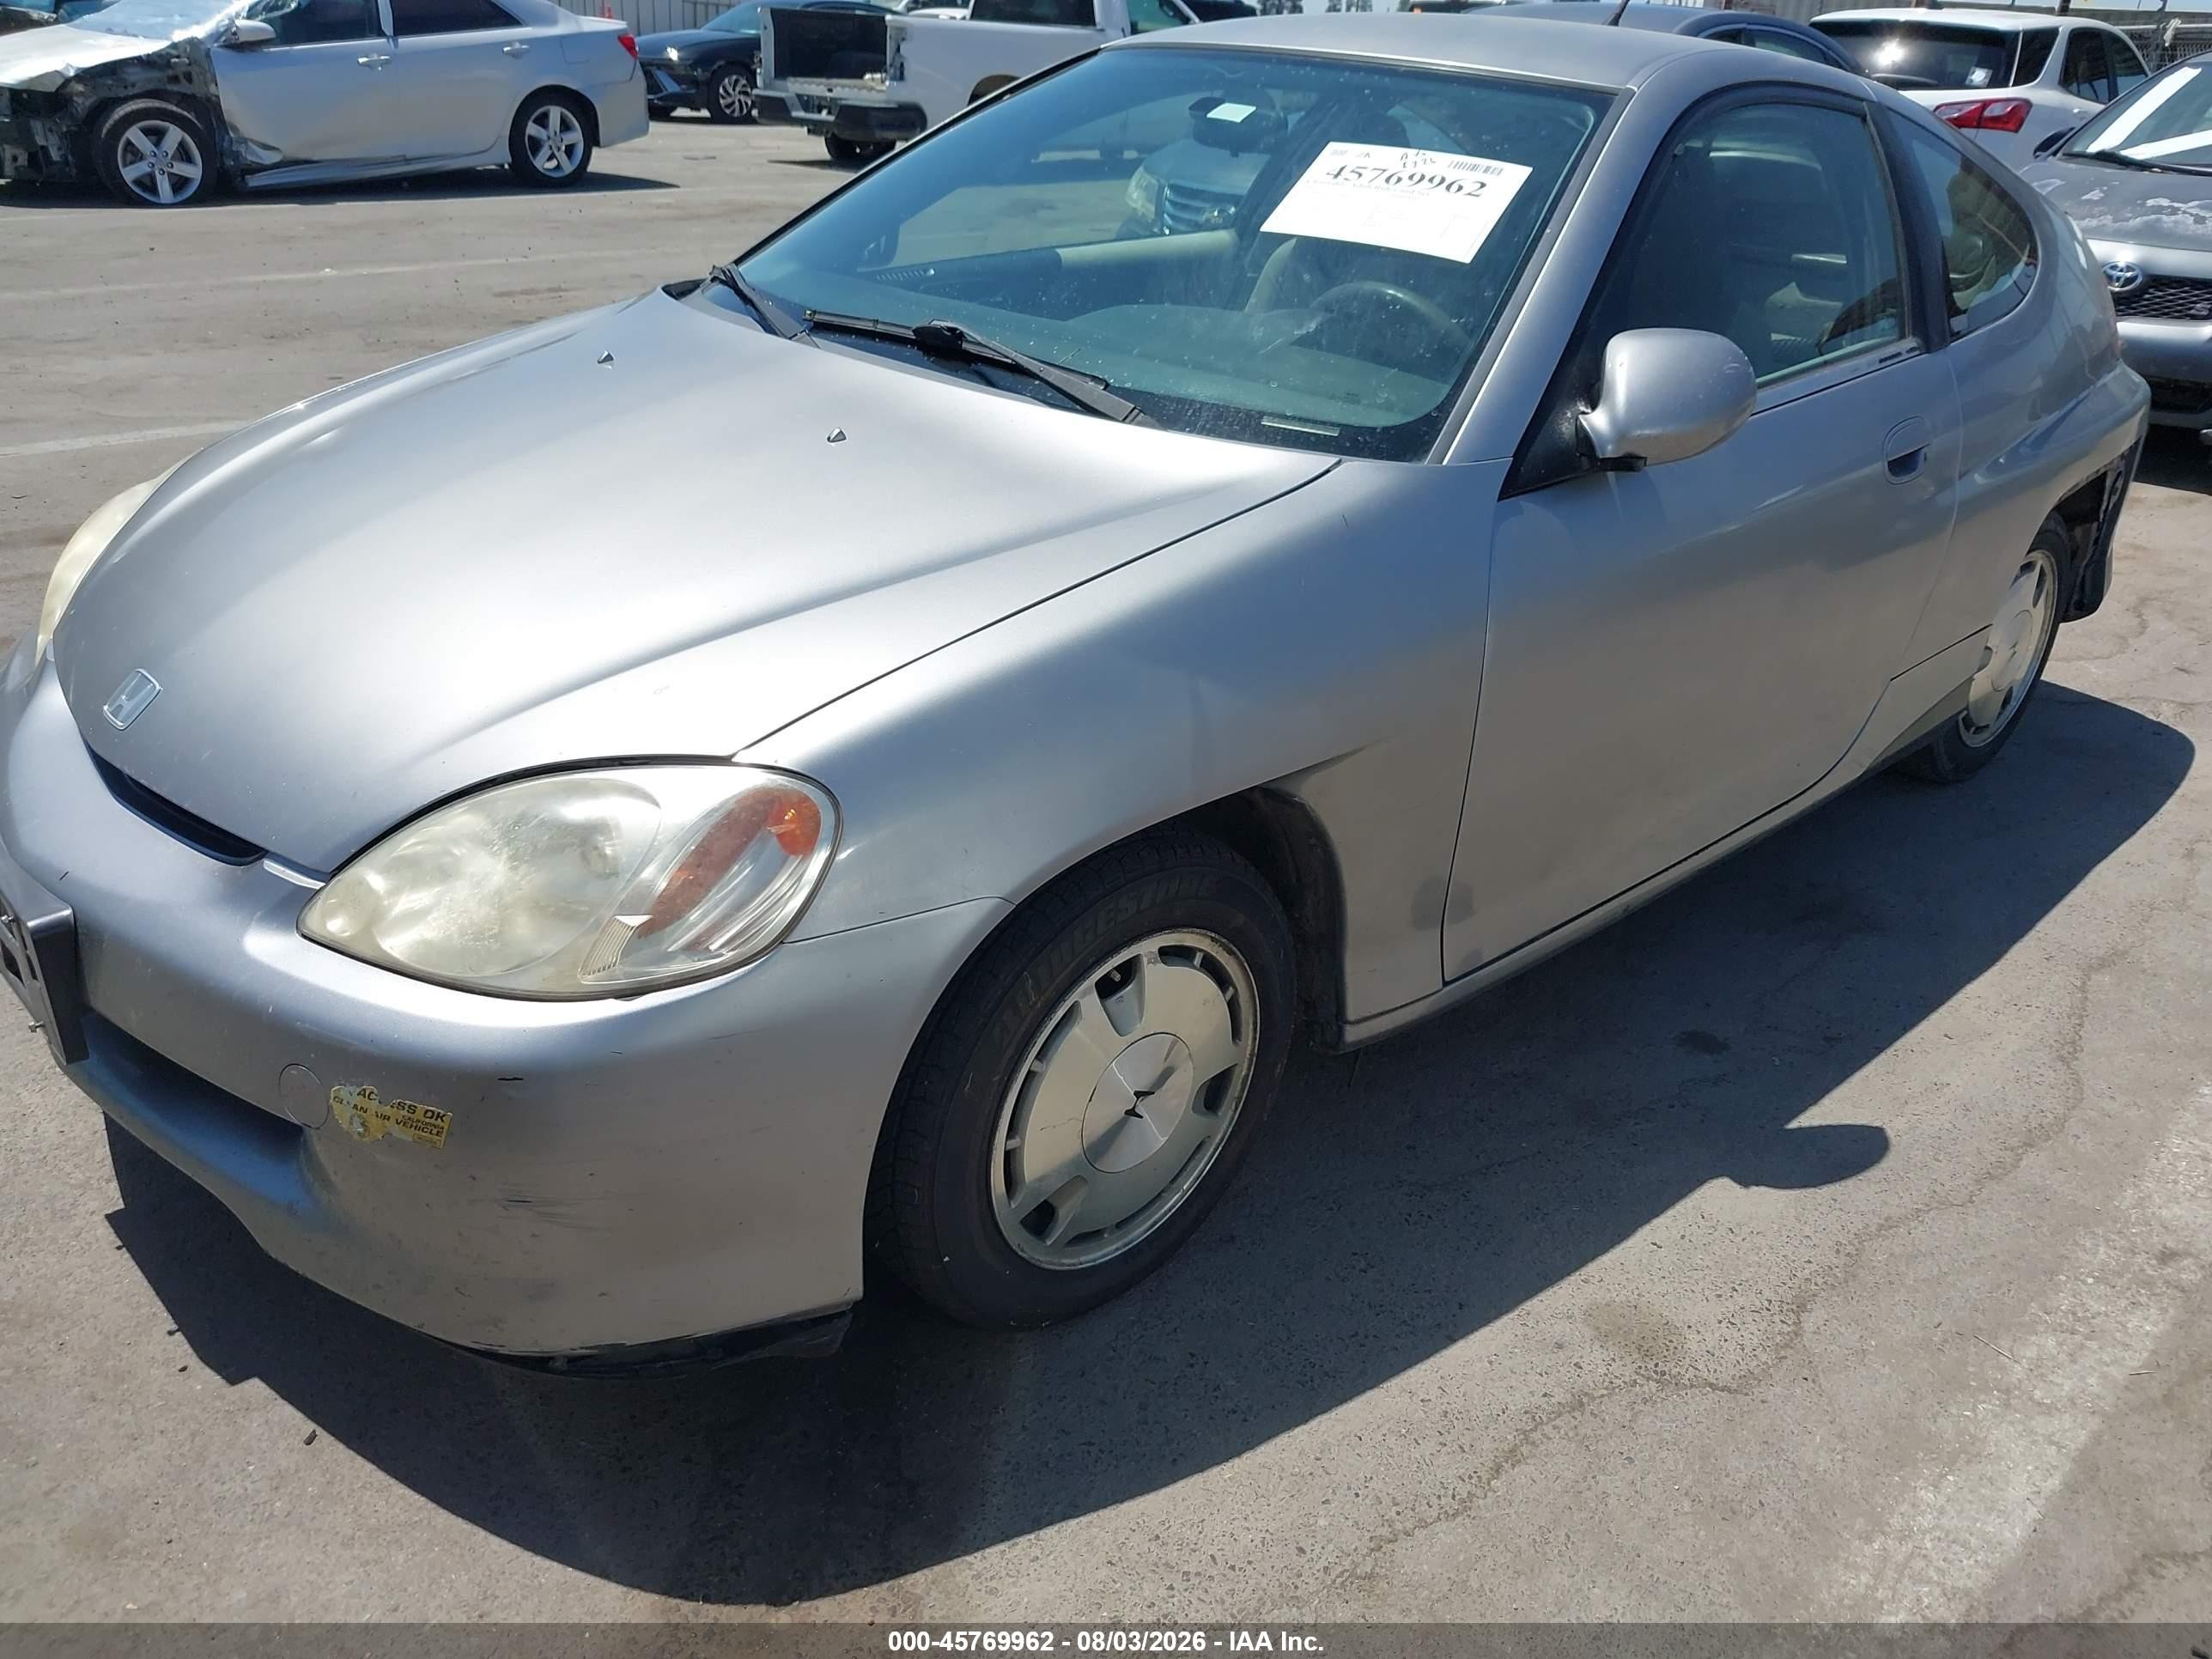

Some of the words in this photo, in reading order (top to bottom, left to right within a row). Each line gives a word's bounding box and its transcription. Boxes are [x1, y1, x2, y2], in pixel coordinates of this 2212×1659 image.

[1326, 164, 1487, 198] 45769962
[423, 1109, 446, 1123] OK
[395, 1118, 444, 1138] VEHICLE
